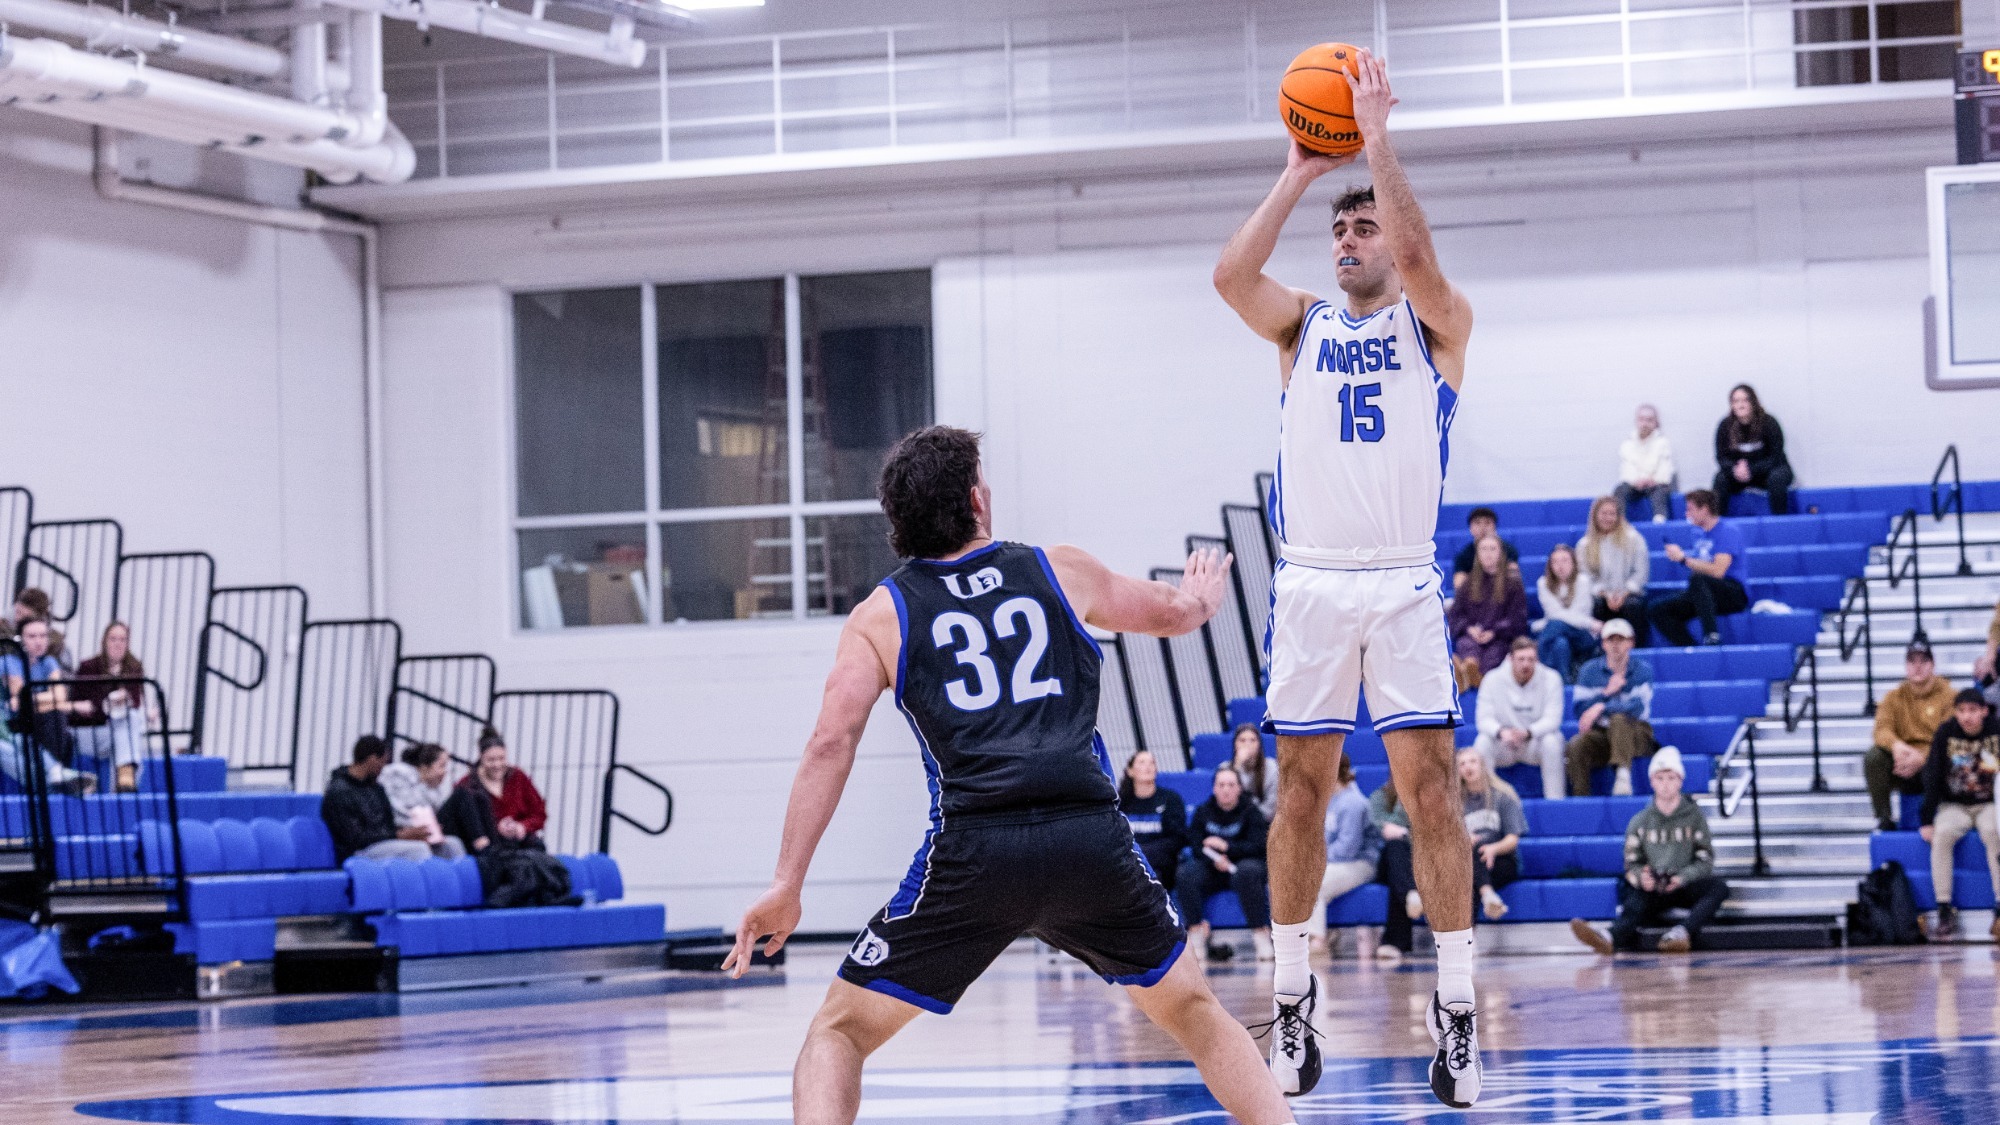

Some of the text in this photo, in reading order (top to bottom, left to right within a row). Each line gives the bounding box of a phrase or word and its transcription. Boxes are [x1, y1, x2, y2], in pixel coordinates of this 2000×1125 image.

[1289, 106, 1359, 142] Wilson
[1316, 335, 1401, 376] NORSE
[1338, 382, 1385, 442] 15
[931, 596, 1063, 711] 32
